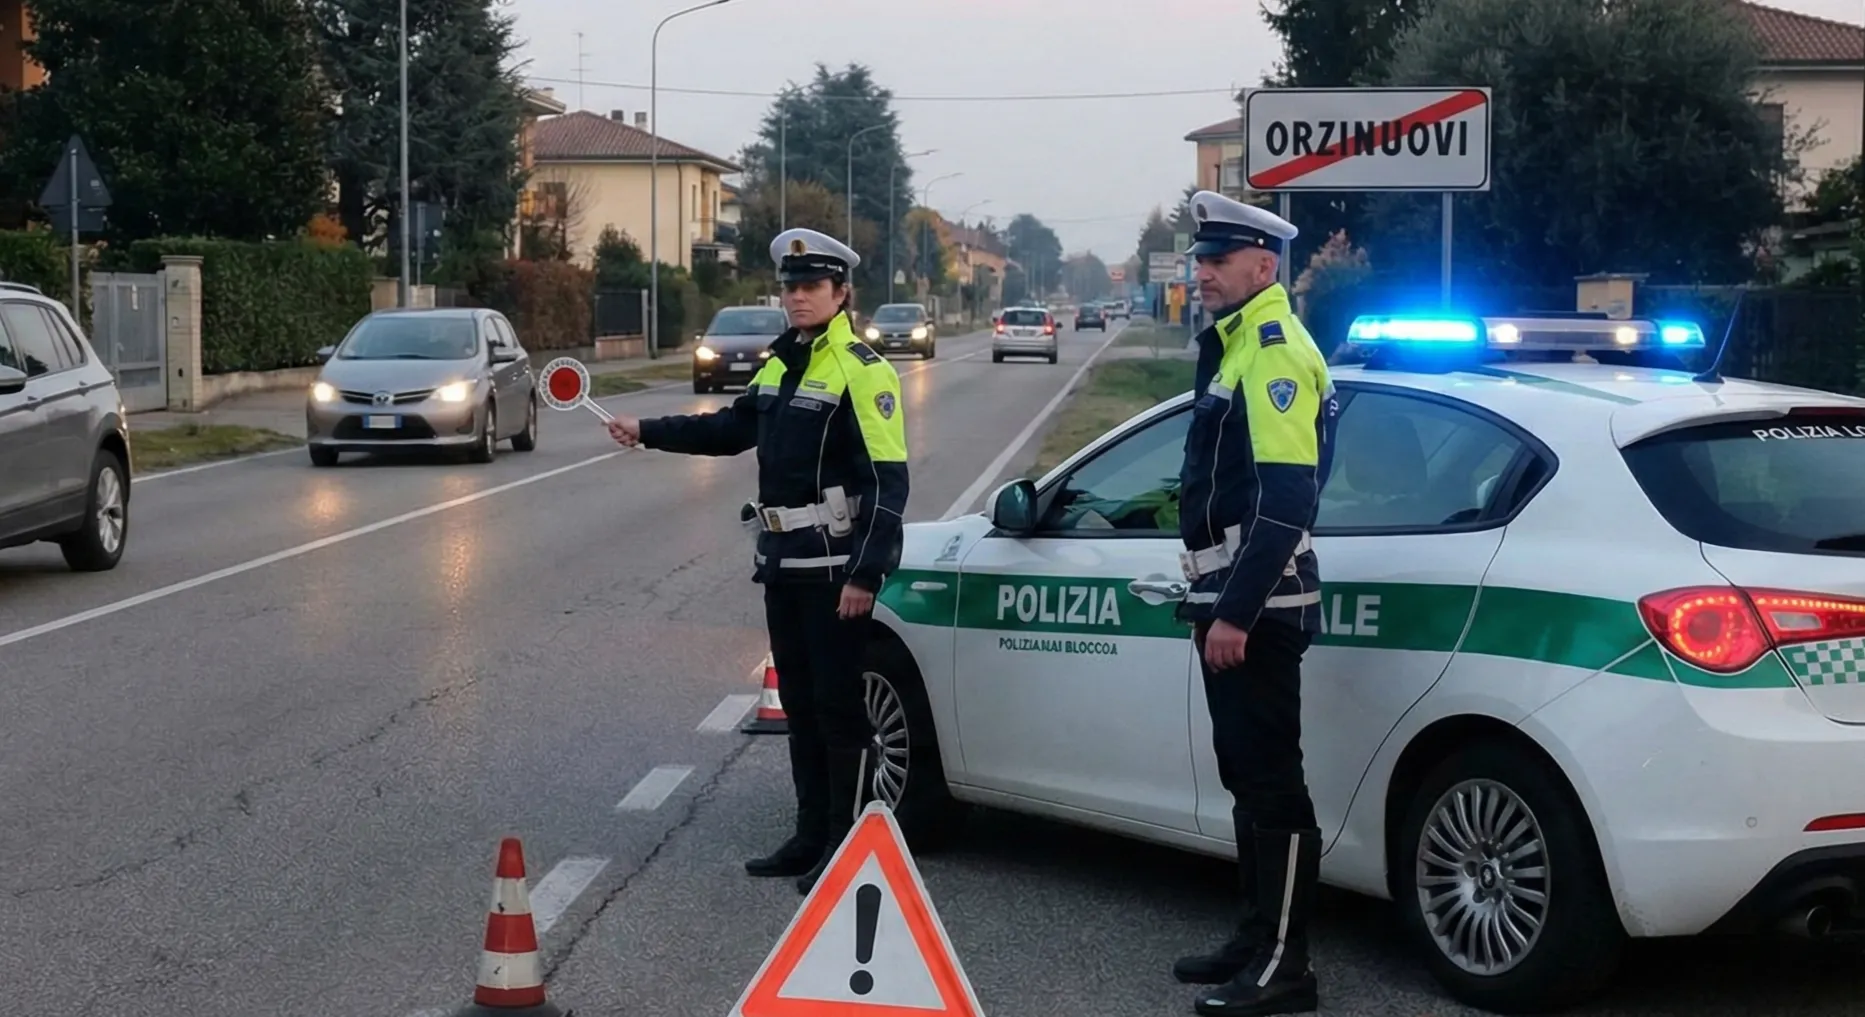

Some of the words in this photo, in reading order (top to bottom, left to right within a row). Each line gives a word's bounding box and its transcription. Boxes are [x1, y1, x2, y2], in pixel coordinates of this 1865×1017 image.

[1265, 120, 1468, 157] ORZINUOVI
[1751, 425, 1845, 442] POLIZIA
[996, 584, 1122, 626] POLIZIA
[1320, 593, 1382, 637] LE
